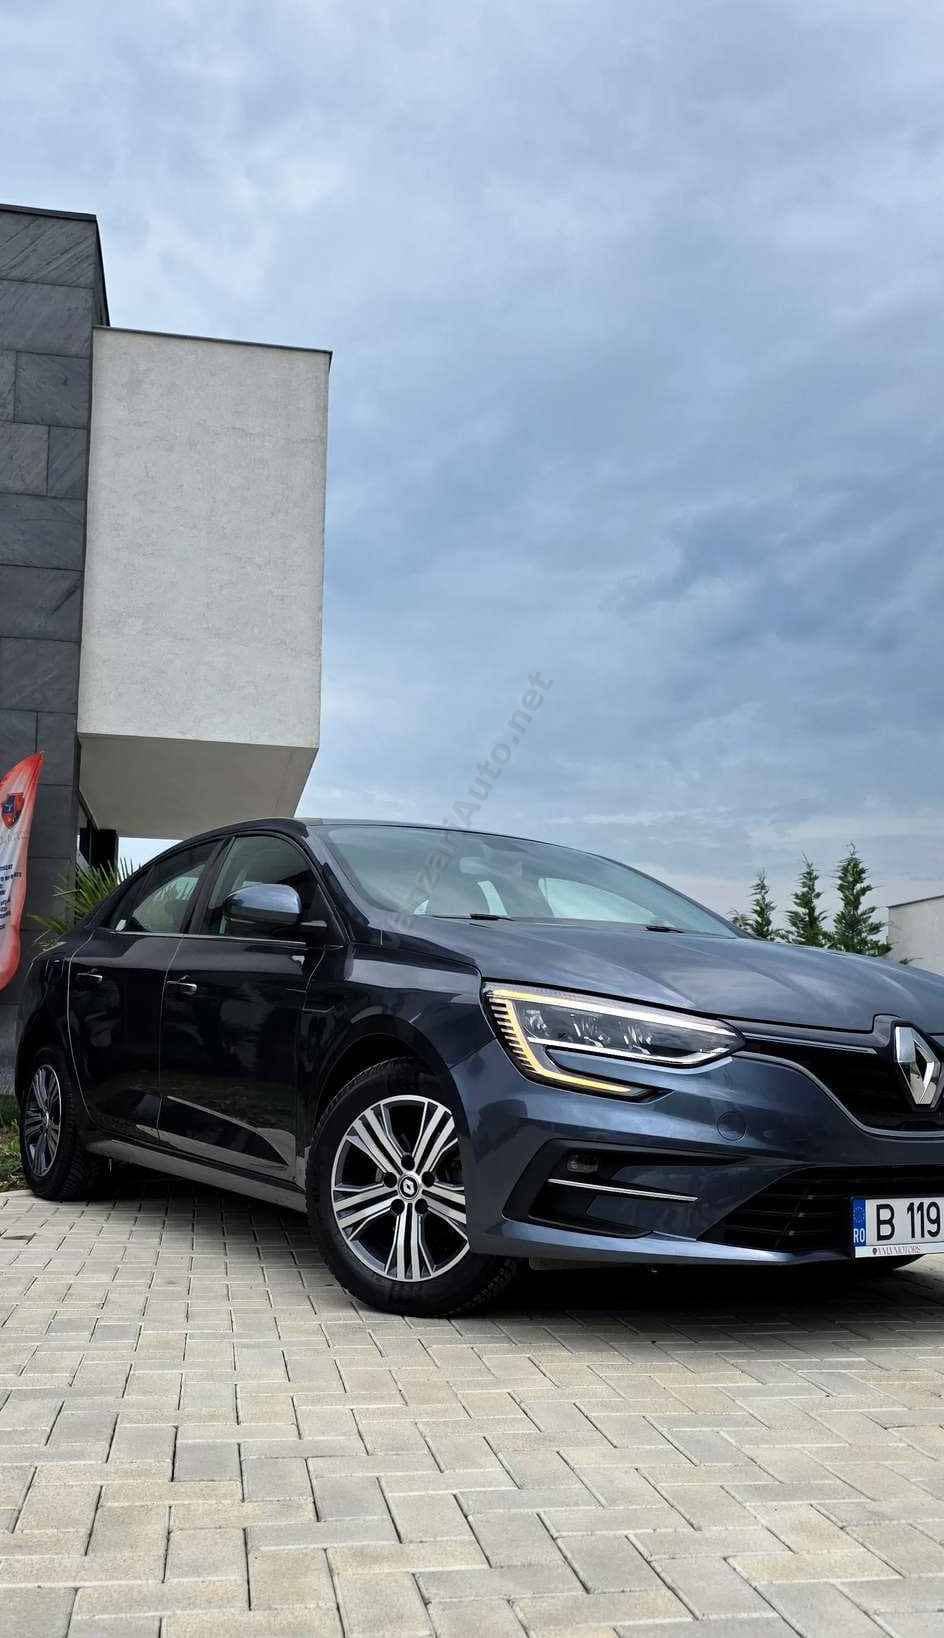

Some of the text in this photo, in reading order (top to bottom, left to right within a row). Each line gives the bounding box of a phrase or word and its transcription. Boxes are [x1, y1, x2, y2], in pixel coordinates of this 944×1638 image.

[876, 1202, 941, 1241] B 119
[853, 1228, 865, 1243] RO
